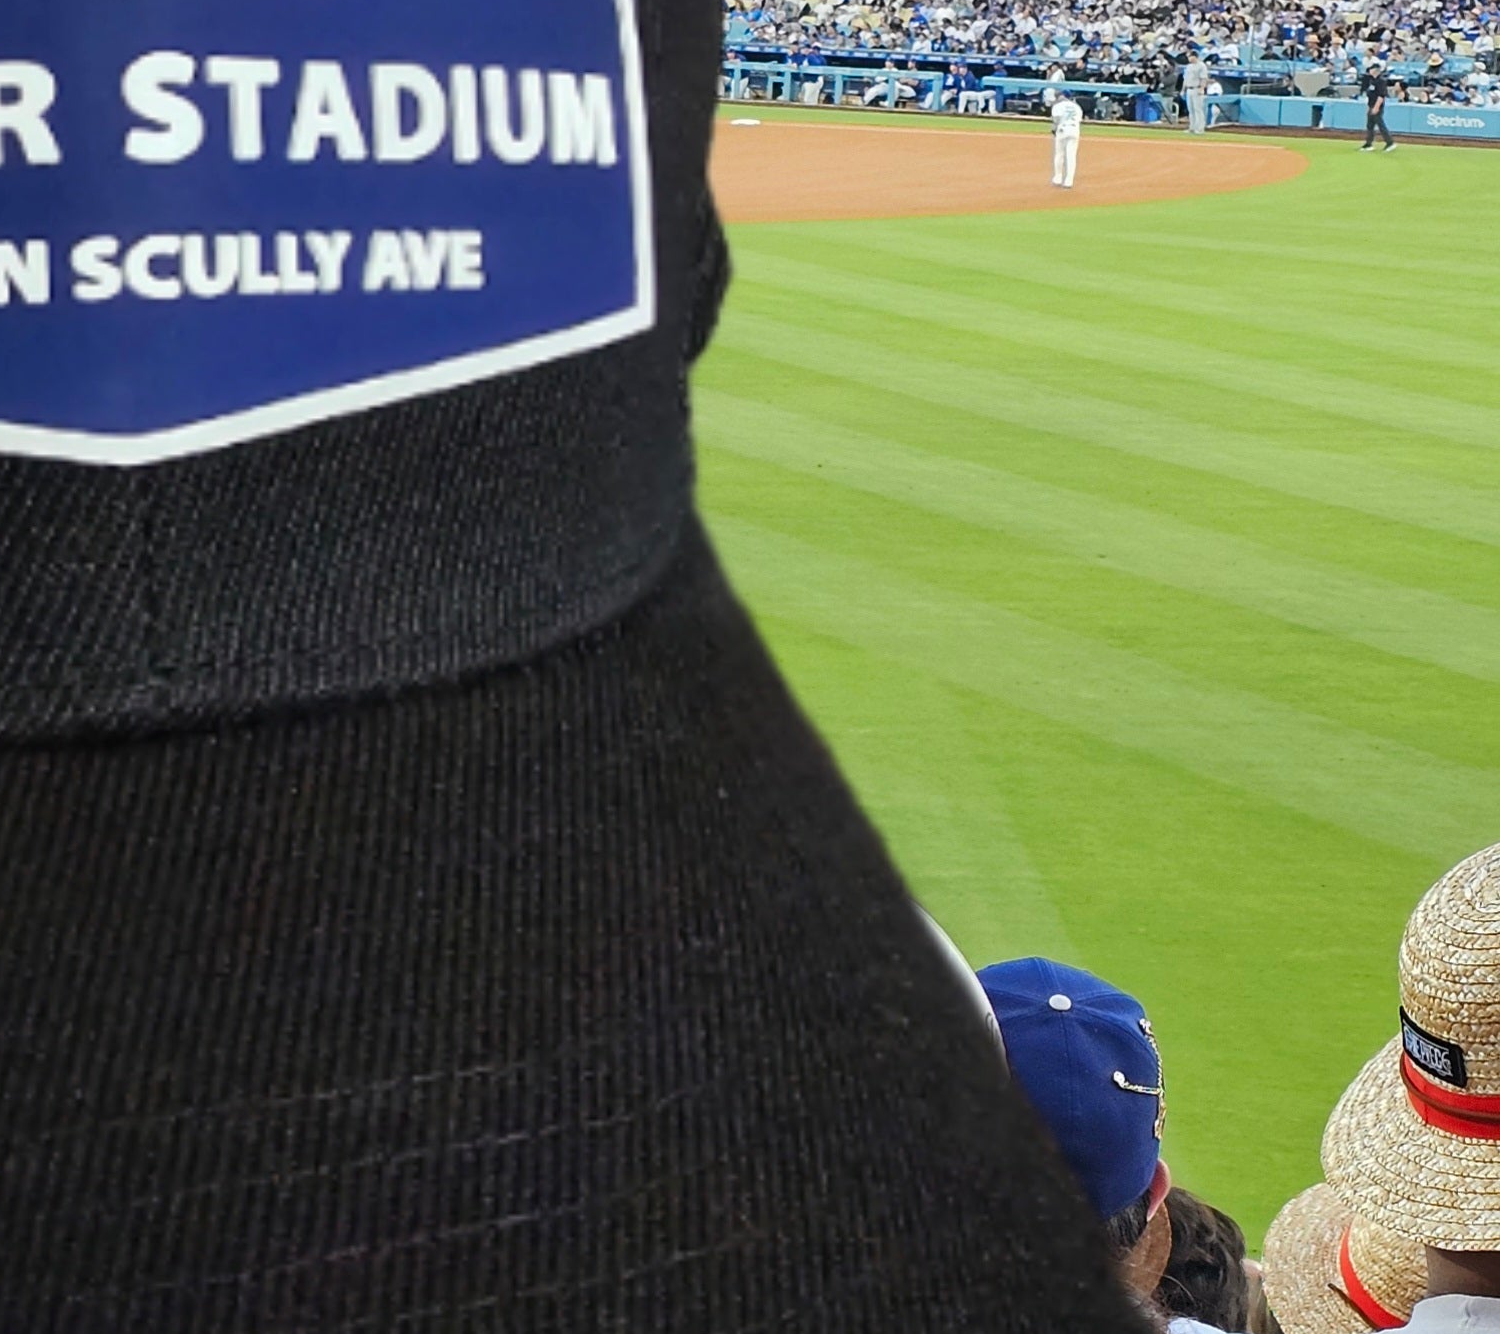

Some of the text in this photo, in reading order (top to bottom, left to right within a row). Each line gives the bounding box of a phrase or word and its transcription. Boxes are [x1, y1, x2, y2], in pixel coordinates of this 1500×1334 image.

[121, 51, 617, 168] STADIUM
[1426, 113, 1481, 129] Spectrum
[70, 231, 352, 302] SCULLY
[363, 229, 485, 293] AVE
